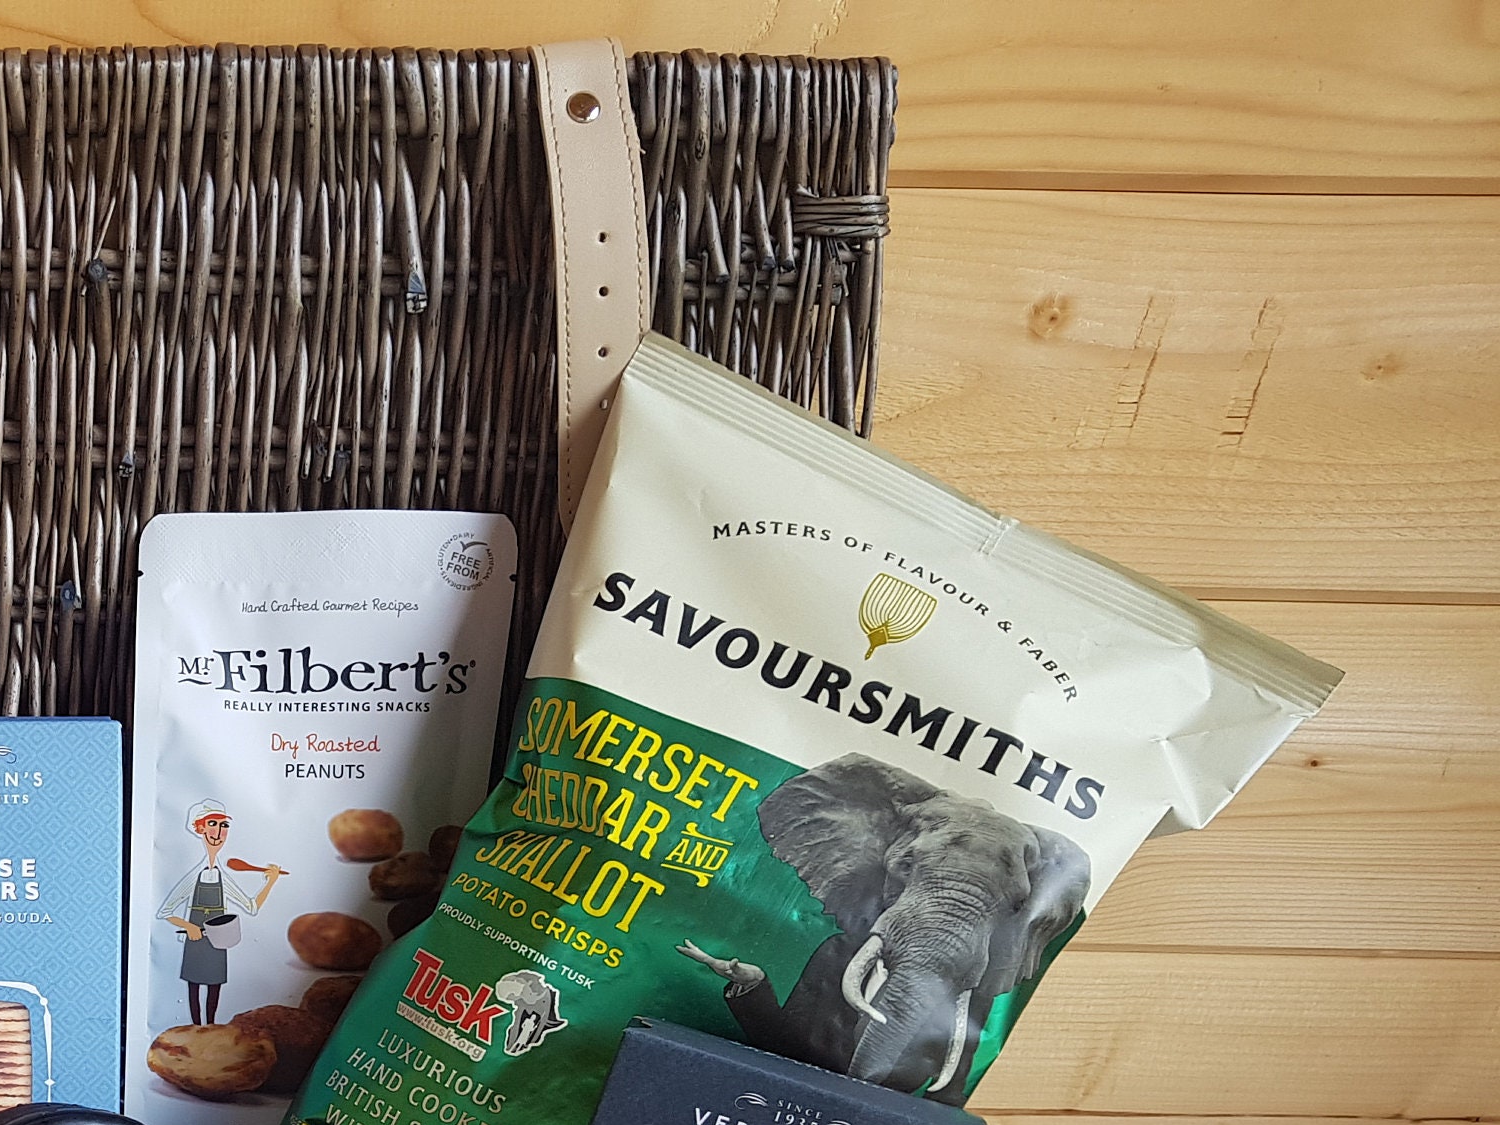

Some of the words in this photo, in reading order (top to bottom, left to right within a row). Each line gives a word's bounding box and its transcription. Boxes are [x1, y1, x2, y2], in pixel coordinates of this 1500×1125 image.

[446, 562, 479, 581] FROM
[451, 552, 481, 570] FREE
[242, 601, 268, 613] Hand
[270, 598, 320, 612] Crafted
[322, 600, 368, 611] Gourmet
[372, 598, 419, 617] Recipes
[712, 520, 833, 542] MASTERS
[844, 535, 875, 554] OF
[883, 550, 990, 618] FLAVOUR
[997, 618, 1014, 633] &
[1017, 636, 1079, 704] FABER
[224, 700, 273, 712] REALLY
[278, 701, 371, 713] INTERESTING
[376, 701, 431, 713] SNACKS
[592, 571, 1106, 820] SAVOURSMITHS
[271, 733, 299, 759] Dry
[306, 733, 381, 753] Roasted
[284, 763, 366, 780] PEANUTS
[518, 696, 758, 823] SOMERSET
[475, 830, 665, 933] SHALLOT
[663, 837, 730, 875] AND
[438, 902, 485, 931] PROUDLY
[483, 926, 558, 971] SUPPORTING
[561, 965, 597, 991] TUSK
[452, 873, 528, 918] POTATO
[530, 910, 624, 968] CRISPS
[402, 949, 510, 1046] Tusk
[397, 1003, 485, 1061] www.tusk.org
[347, 1047, 403, 1093] HAND
[377, 1029, 507, 1114] LUXURIOUS
[777, 1099, 823, 1120] SINCE
